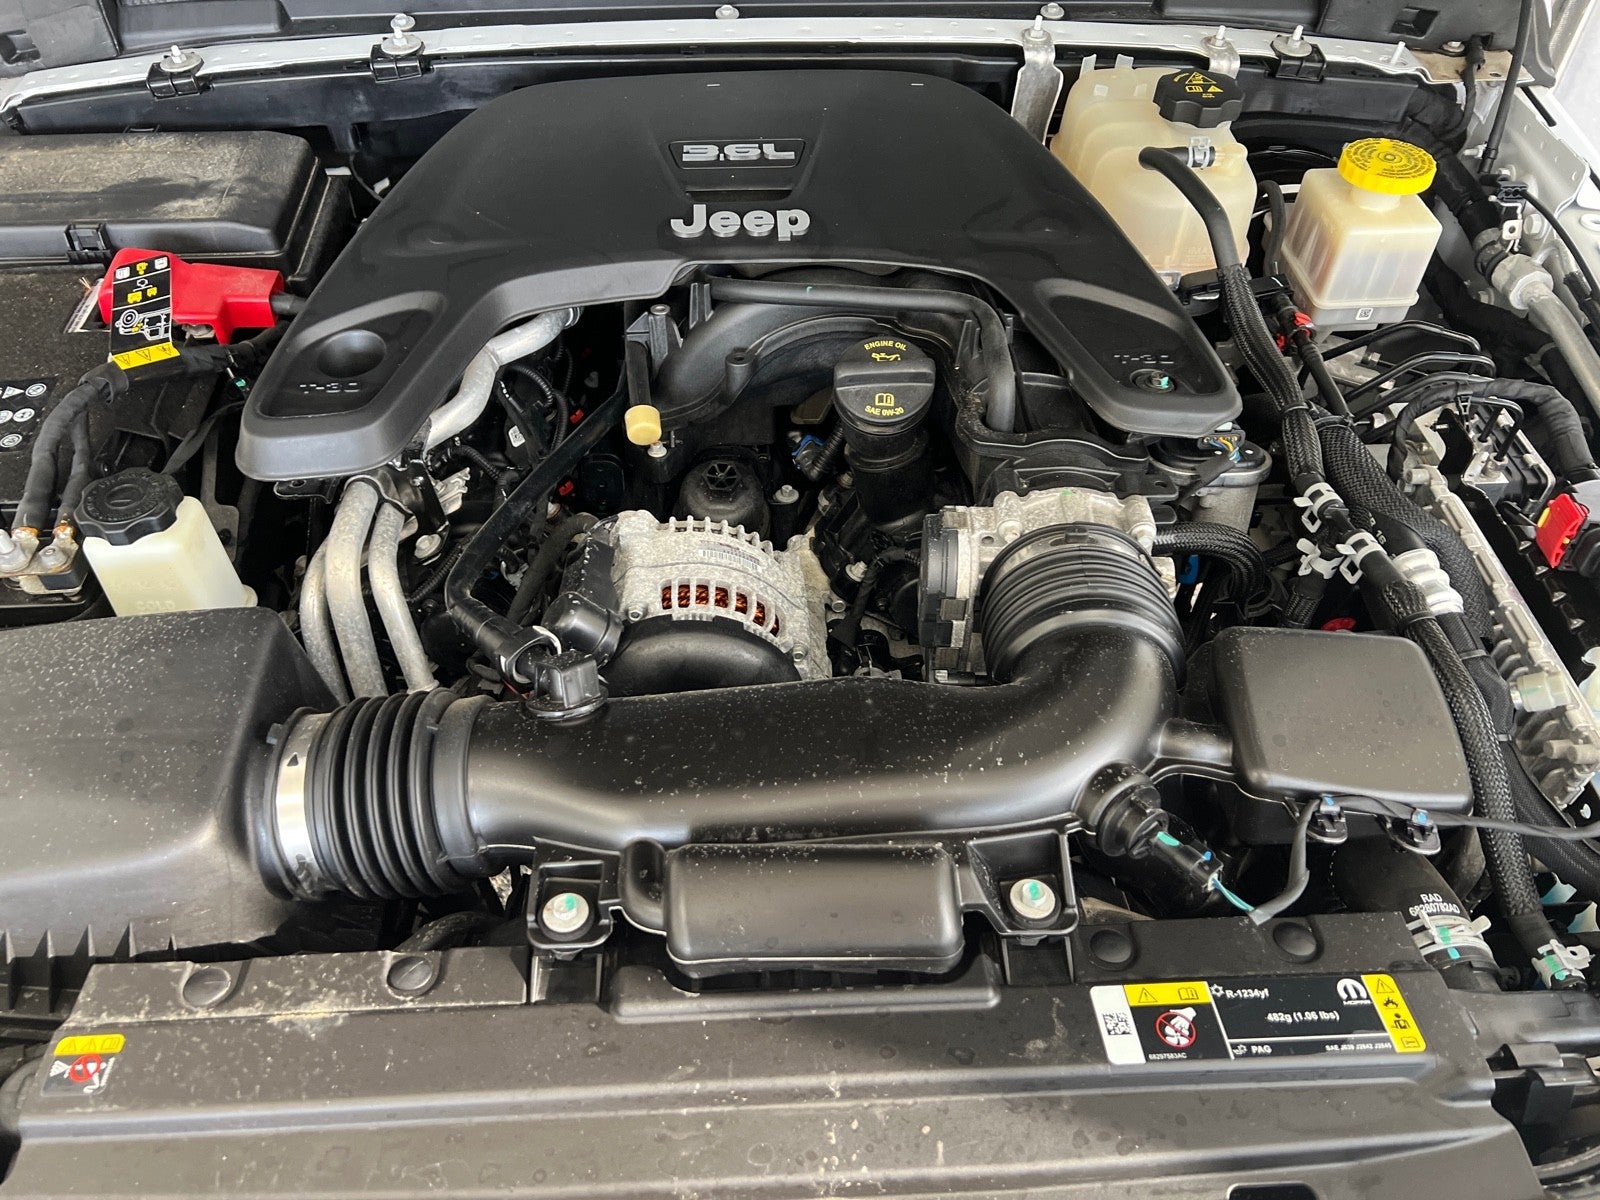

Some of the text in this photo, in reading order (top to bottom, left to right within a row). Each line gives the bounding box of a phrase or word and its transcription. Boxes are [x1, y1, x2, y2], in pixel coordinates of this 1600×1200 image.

[682, 143, 795, 161] 3.6L
[670, 204, 811, 241] Jeep
[864, 341, 907, 351] ENGINE OIL
[865, 405, 905, 416] SAE 0W-20
[1420, 893, 1443, 903] RAD
[1225, 988, 1269, 1000] R-1234yf
[1267, 1012, 1292, 1024] 482g
[1319, 1010, 1340, 1022] lbs)
[1251, 1044, 1272, 1054] PAG
